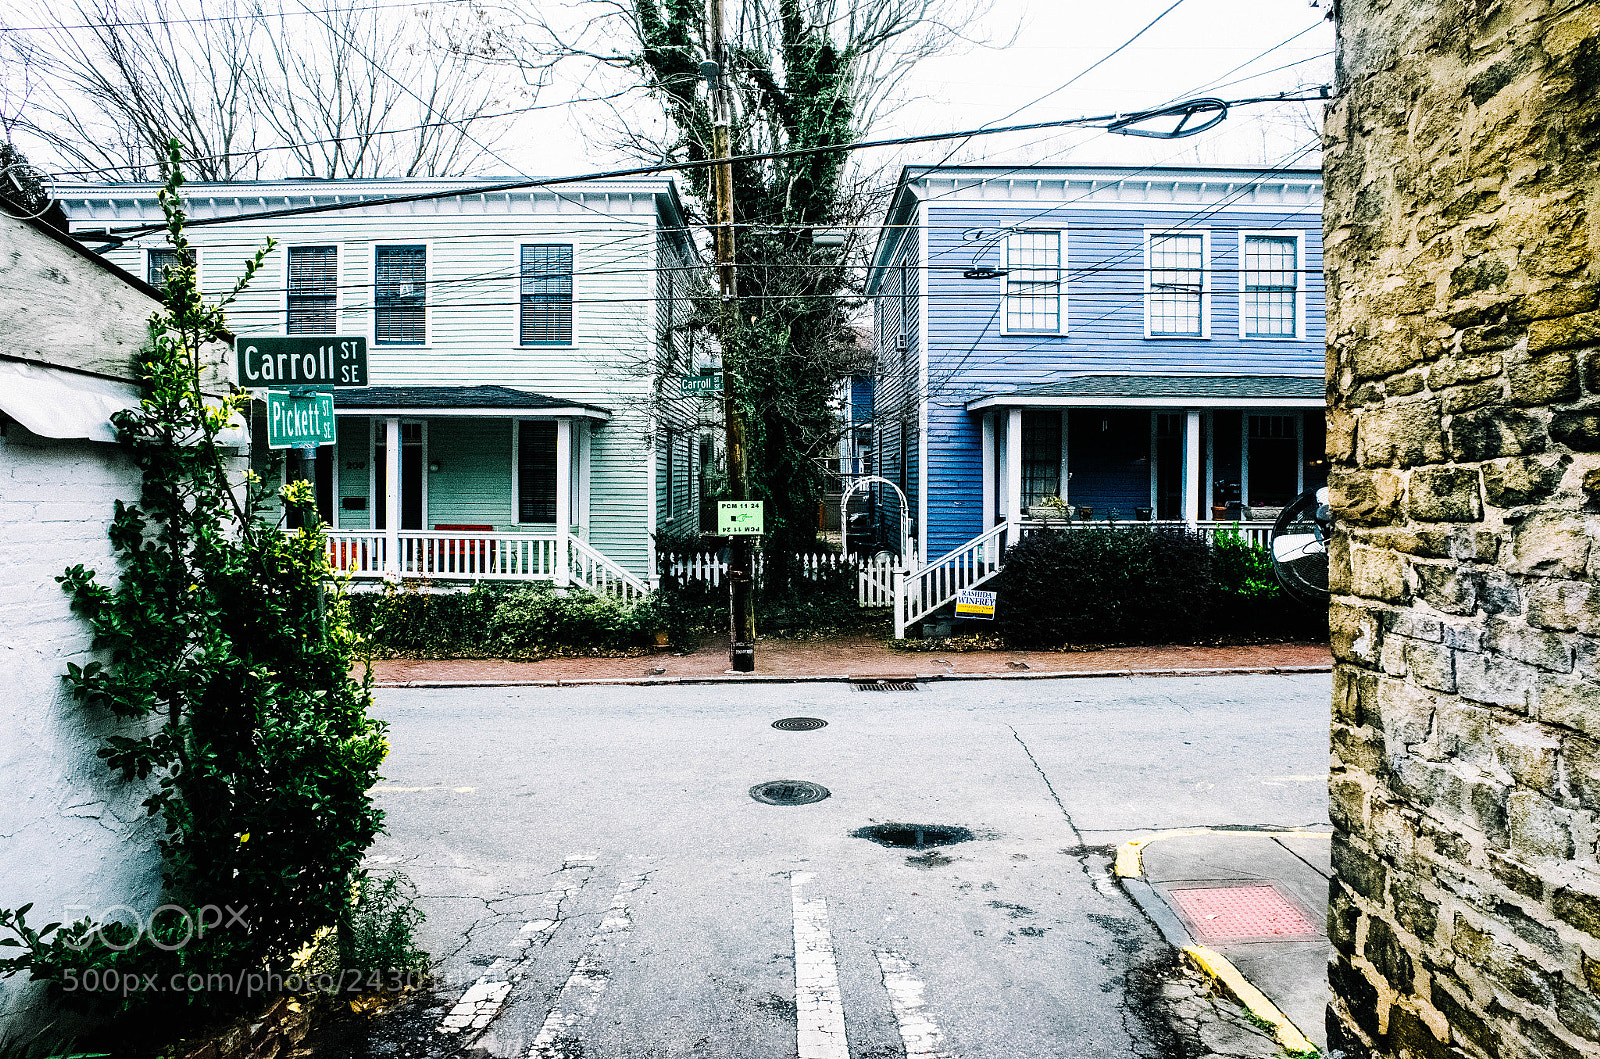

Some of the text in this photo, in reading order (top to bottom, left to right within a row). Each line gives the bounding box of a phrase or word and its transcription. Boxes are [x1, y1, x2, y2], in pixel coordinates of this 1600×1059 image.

[244, 341, 360, 383] Carroll ST SE
[682, 378, 711, 390] Carroll
[272, 400, 332, 439] Pickett ST SE
[962, 590, 992, 598] RASHIDA
[958, 597, 995, 606] WINFREY
